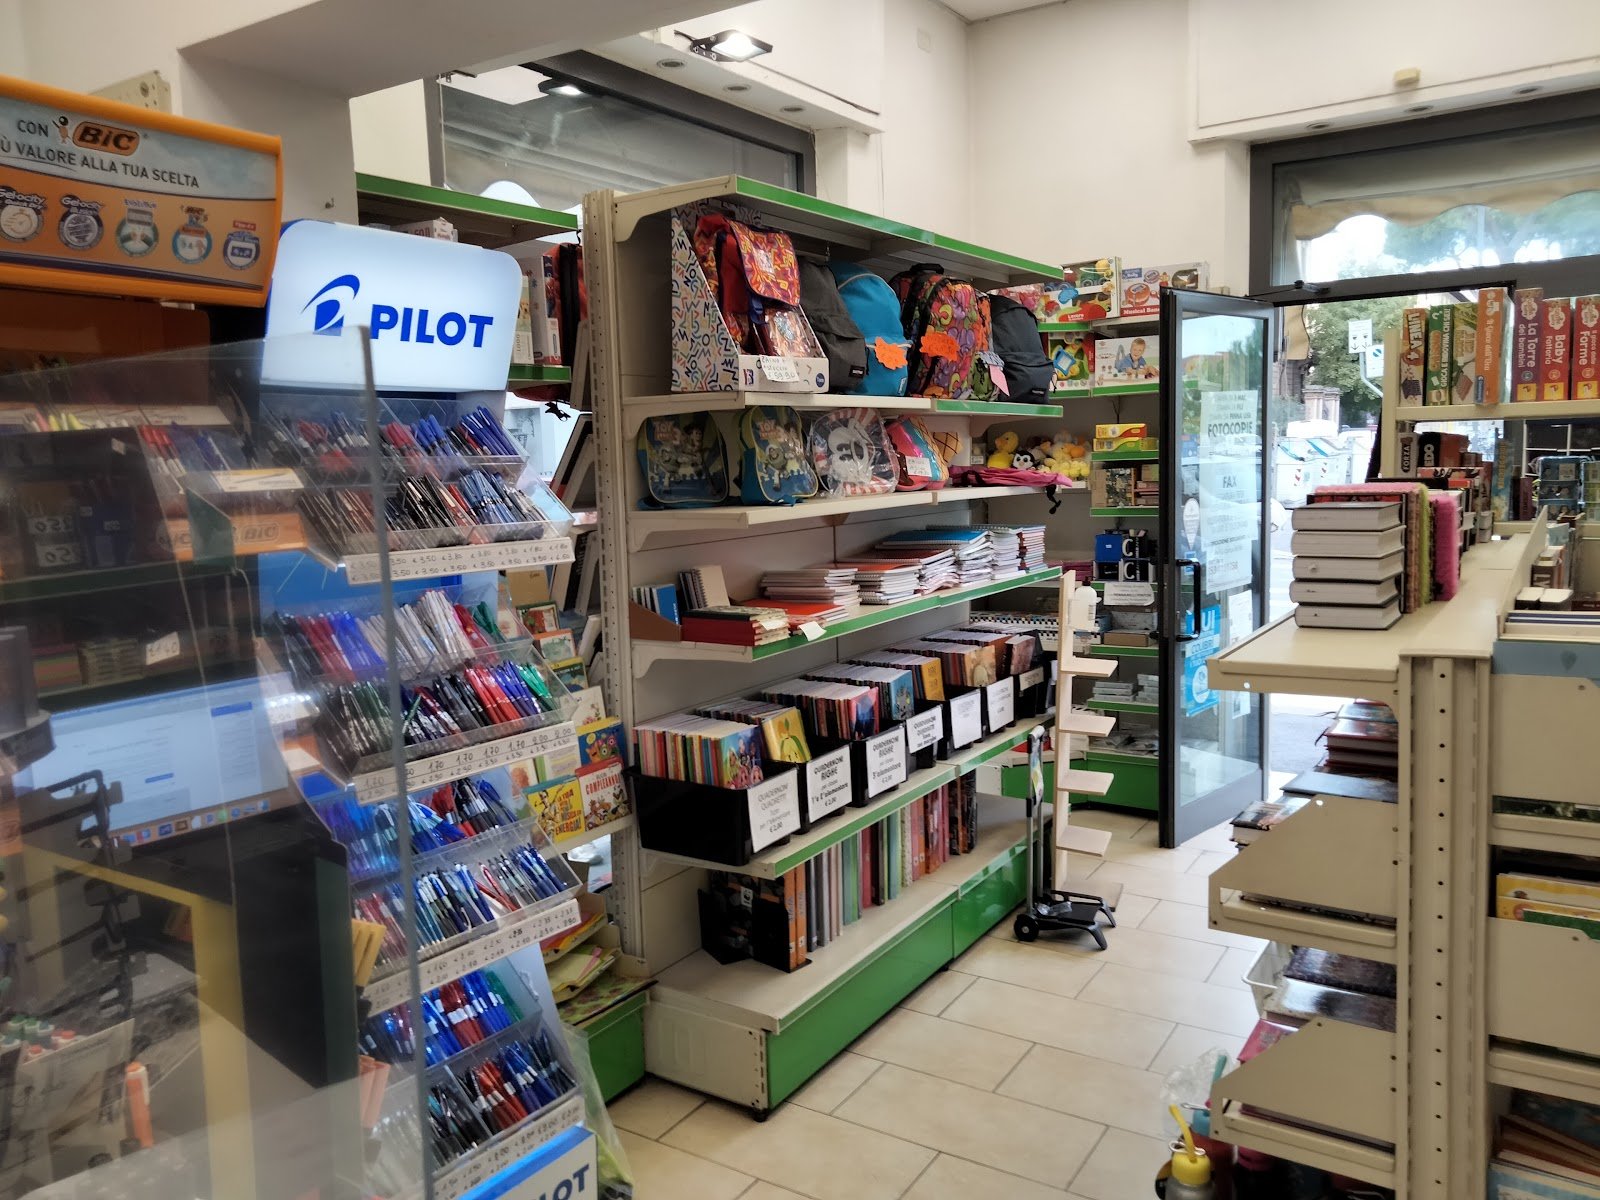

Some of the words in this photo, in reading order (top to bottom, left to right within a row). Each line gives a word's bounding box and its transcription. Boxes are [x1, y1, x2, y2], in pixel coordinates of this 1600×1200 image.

[17, 119, 49, 138] CON
[15, 142, 76, 165] VALORE
[81, 156, 118, 174] ALLA
[122, 163, 150, 179] TUA
[152, 169, 199, 188] SCELTA
[370, 304, 493, 348] PILOT
[1407, 313, 1423, 349] LINEA
[1519, 324, 1527, 336] dei
[1528, 323, 1538, 336] La
[1408, 351, 1419, 360] 4
[1518, 337, 1526, 368] bambini
[1527, 337, 1538, 368] Torre
[1545, 336, 1553, 365] Fattoria
[1552, 335, 1566, 364] Baby
[1579, 330, 1590, 366] Forme
[1208, 421, 1253, 438] FOTOCOPIE
[1222, 475, 1237, 488] FAX
[1193, 610, 1215, 632] UI
[821, 767, 838, 780] RIGHE
